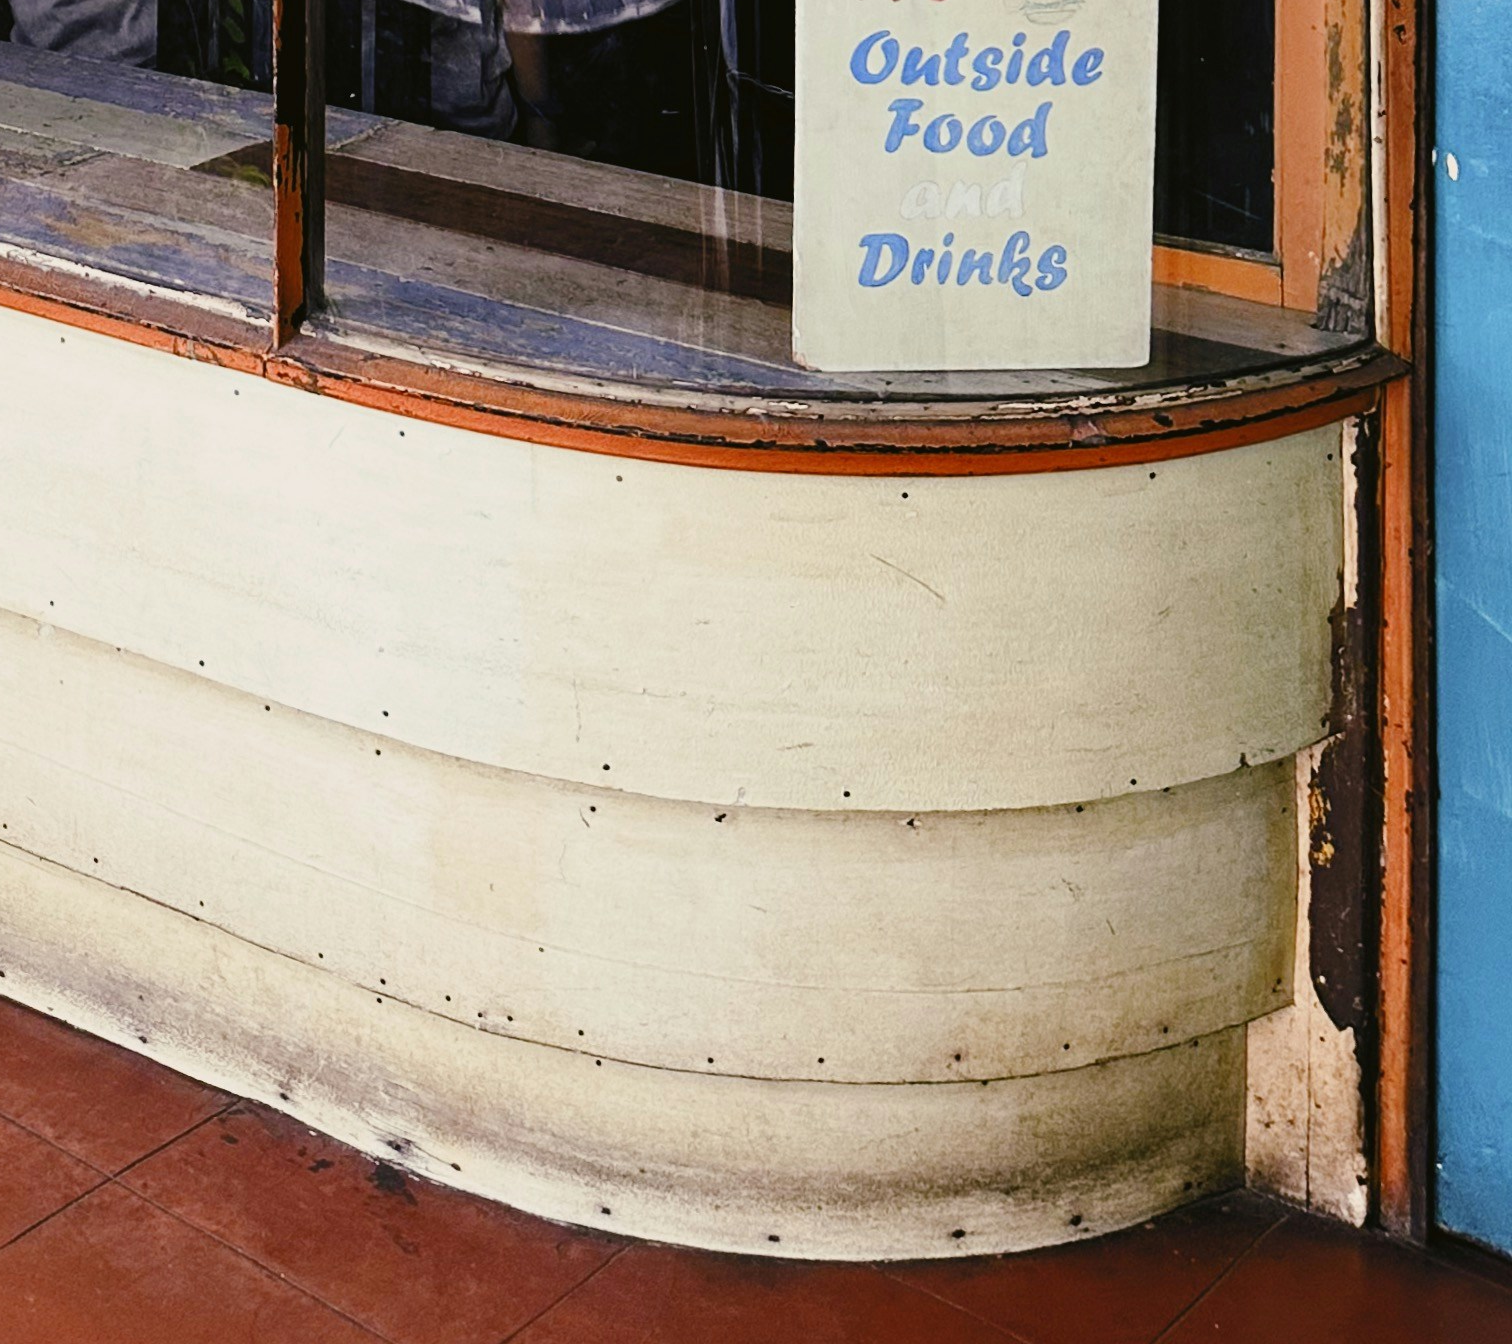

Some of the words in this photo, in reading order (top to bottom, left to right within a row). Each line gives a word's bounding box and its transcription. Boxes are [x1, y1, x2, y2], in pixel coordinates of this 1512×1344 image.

[849, 29, 1105, 91] Outside
[884, 98, 1054, 159] Food
[899, 160, 1027, 220] and
[858, 231, 1069, 297] Drinks
